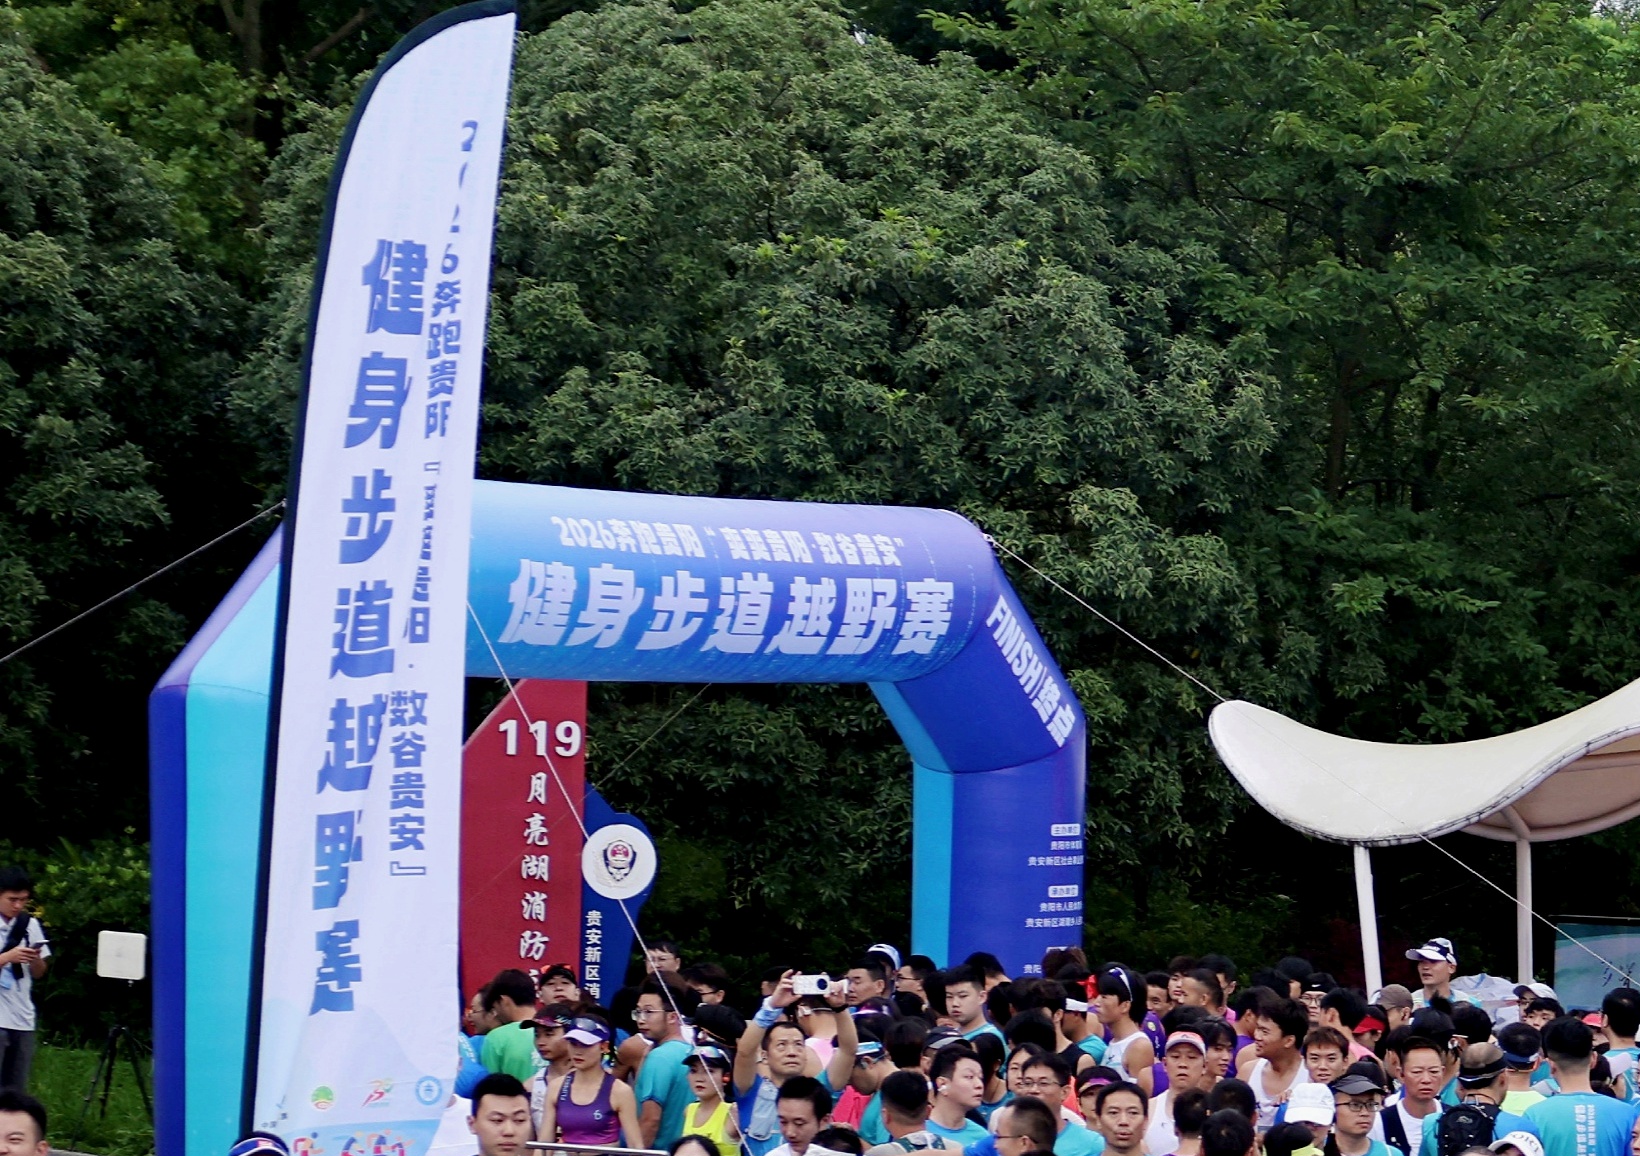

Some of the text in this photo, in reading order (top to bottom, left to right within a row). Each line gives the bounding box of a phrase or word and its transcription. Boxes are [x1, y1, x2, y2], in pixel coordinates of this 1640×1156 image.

[498, 558, 954, 655] 健身步道越野赛
[986, 595, 1042, 700] FINISH
[498, 719, 581, 758] 119
[520, 771, 550, 998] 月亮湖消防
